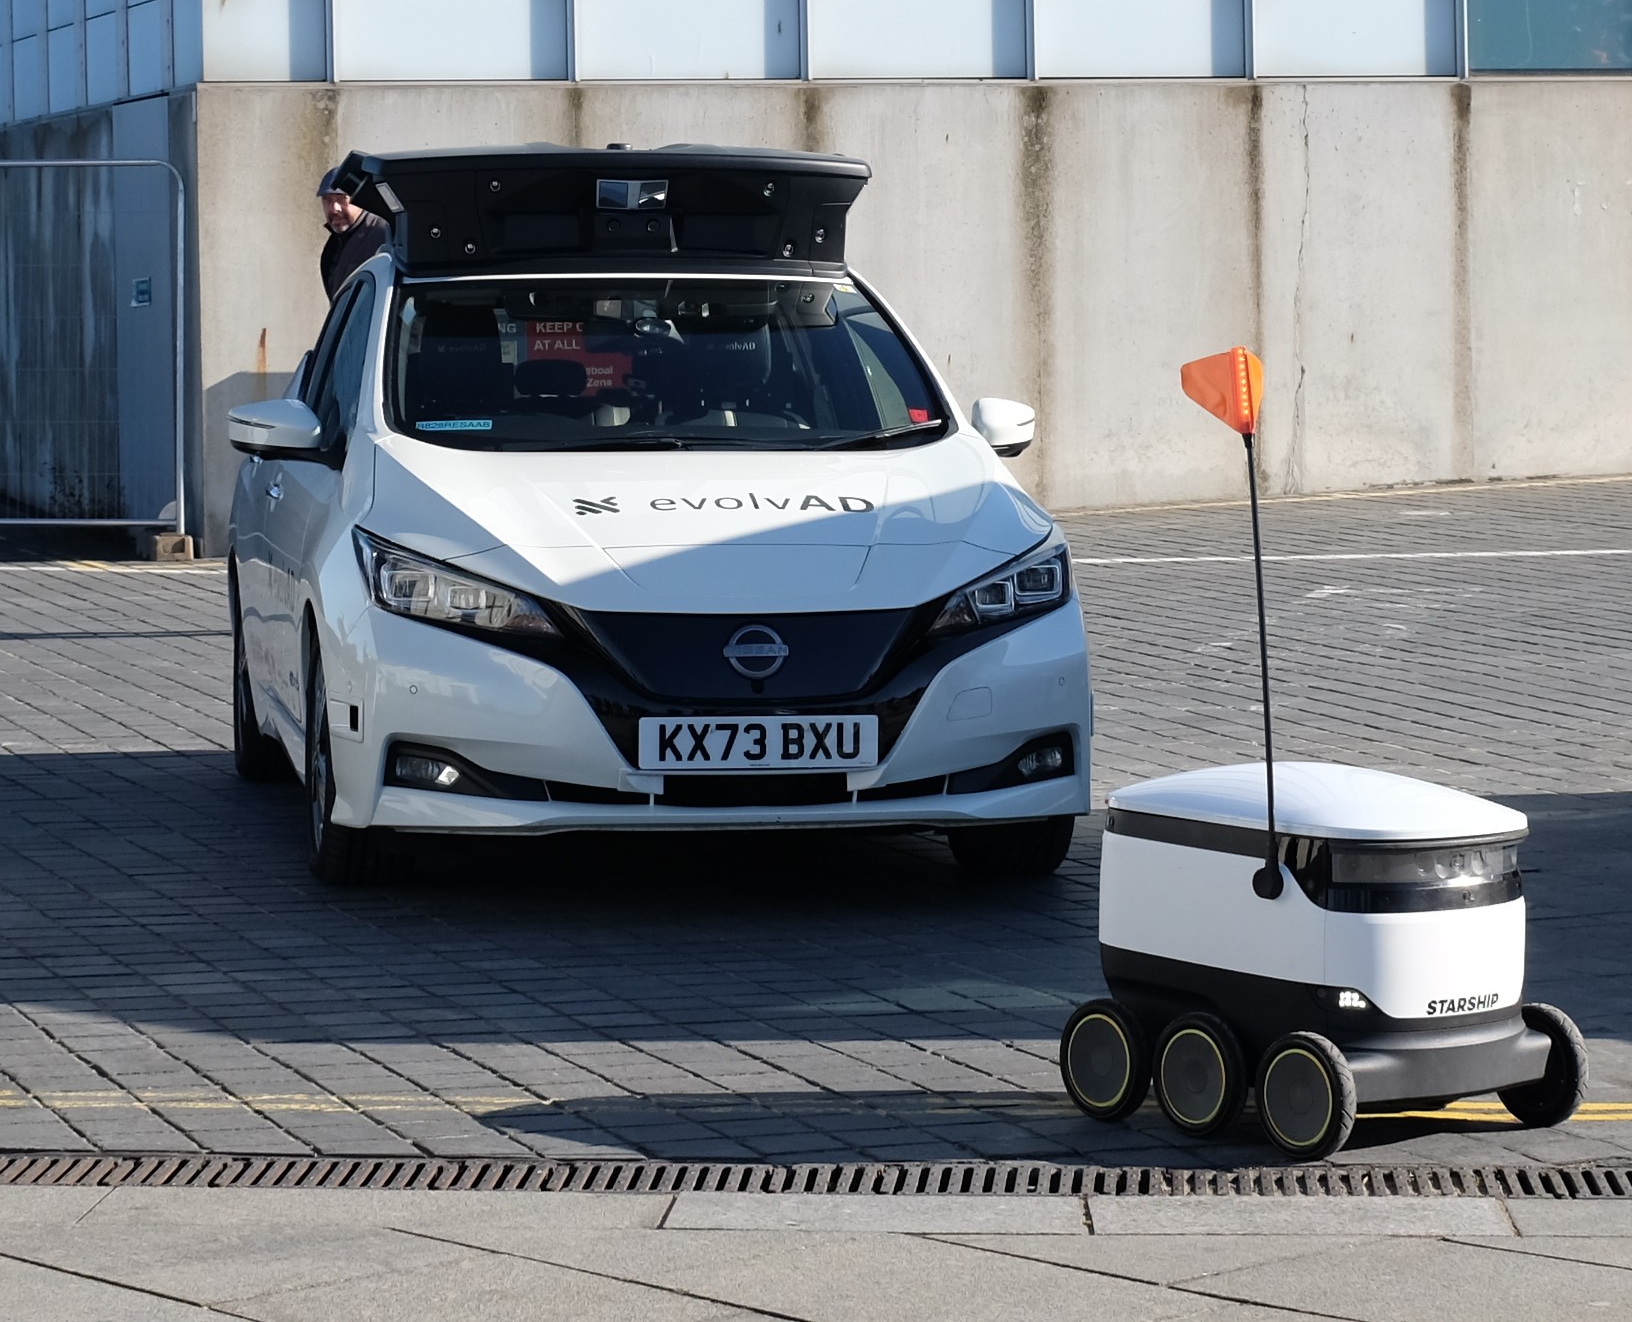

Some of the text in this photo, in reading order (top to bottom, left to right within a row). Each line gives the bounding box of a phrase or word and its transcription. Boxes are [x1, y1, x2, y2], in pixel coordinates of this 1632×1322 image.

[535, 322, 573, 333] KEEP
[533, 339, 580, 351] AT ALL
[649, 492, 875, 513] evolvAD
[658, 722, 861, 761] KX73 BXU
[1426, 992, 1499, 1015] STARSHIP
